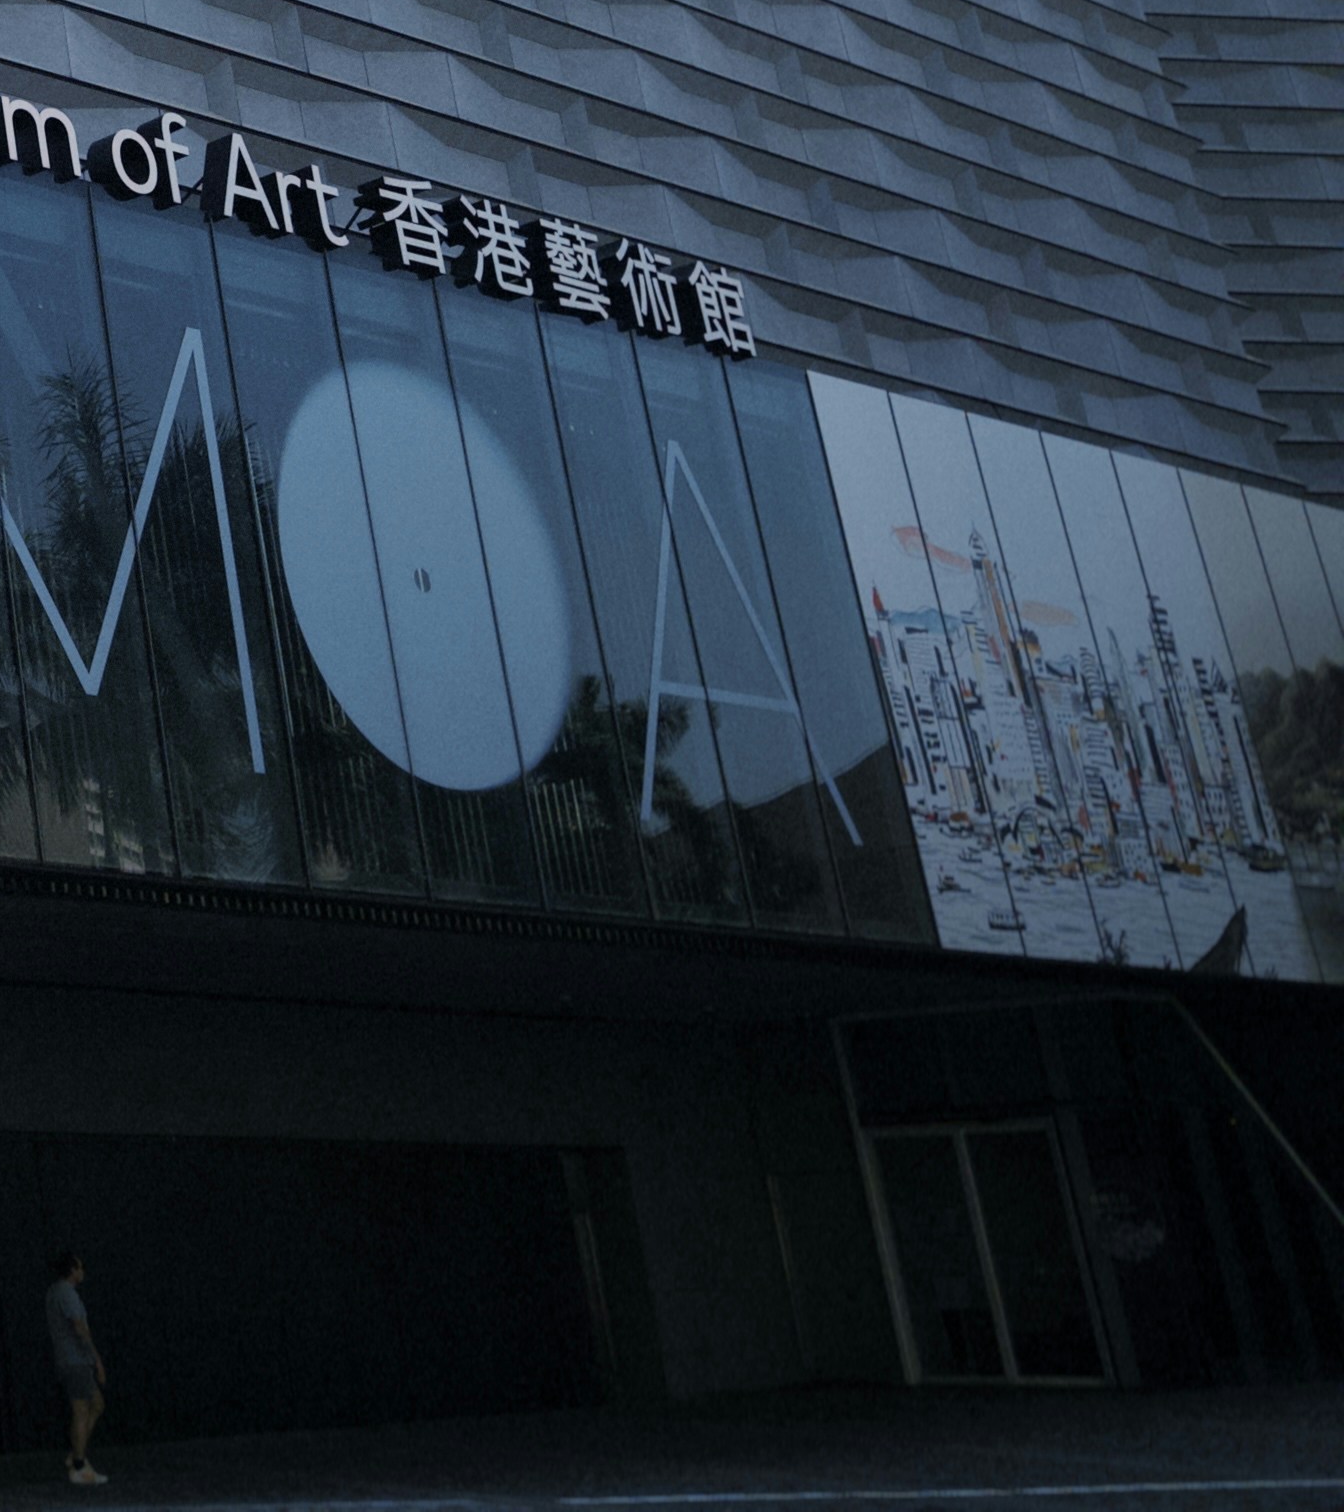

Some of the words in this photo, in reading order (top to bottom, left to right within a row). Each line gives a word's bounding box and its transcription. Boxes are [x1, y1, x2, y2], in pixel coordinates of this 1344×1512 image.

[111, 113, 190, 205] of
[222, 133, 350, 248] Art
[377, 176, 758, 359] 香港藝術館
